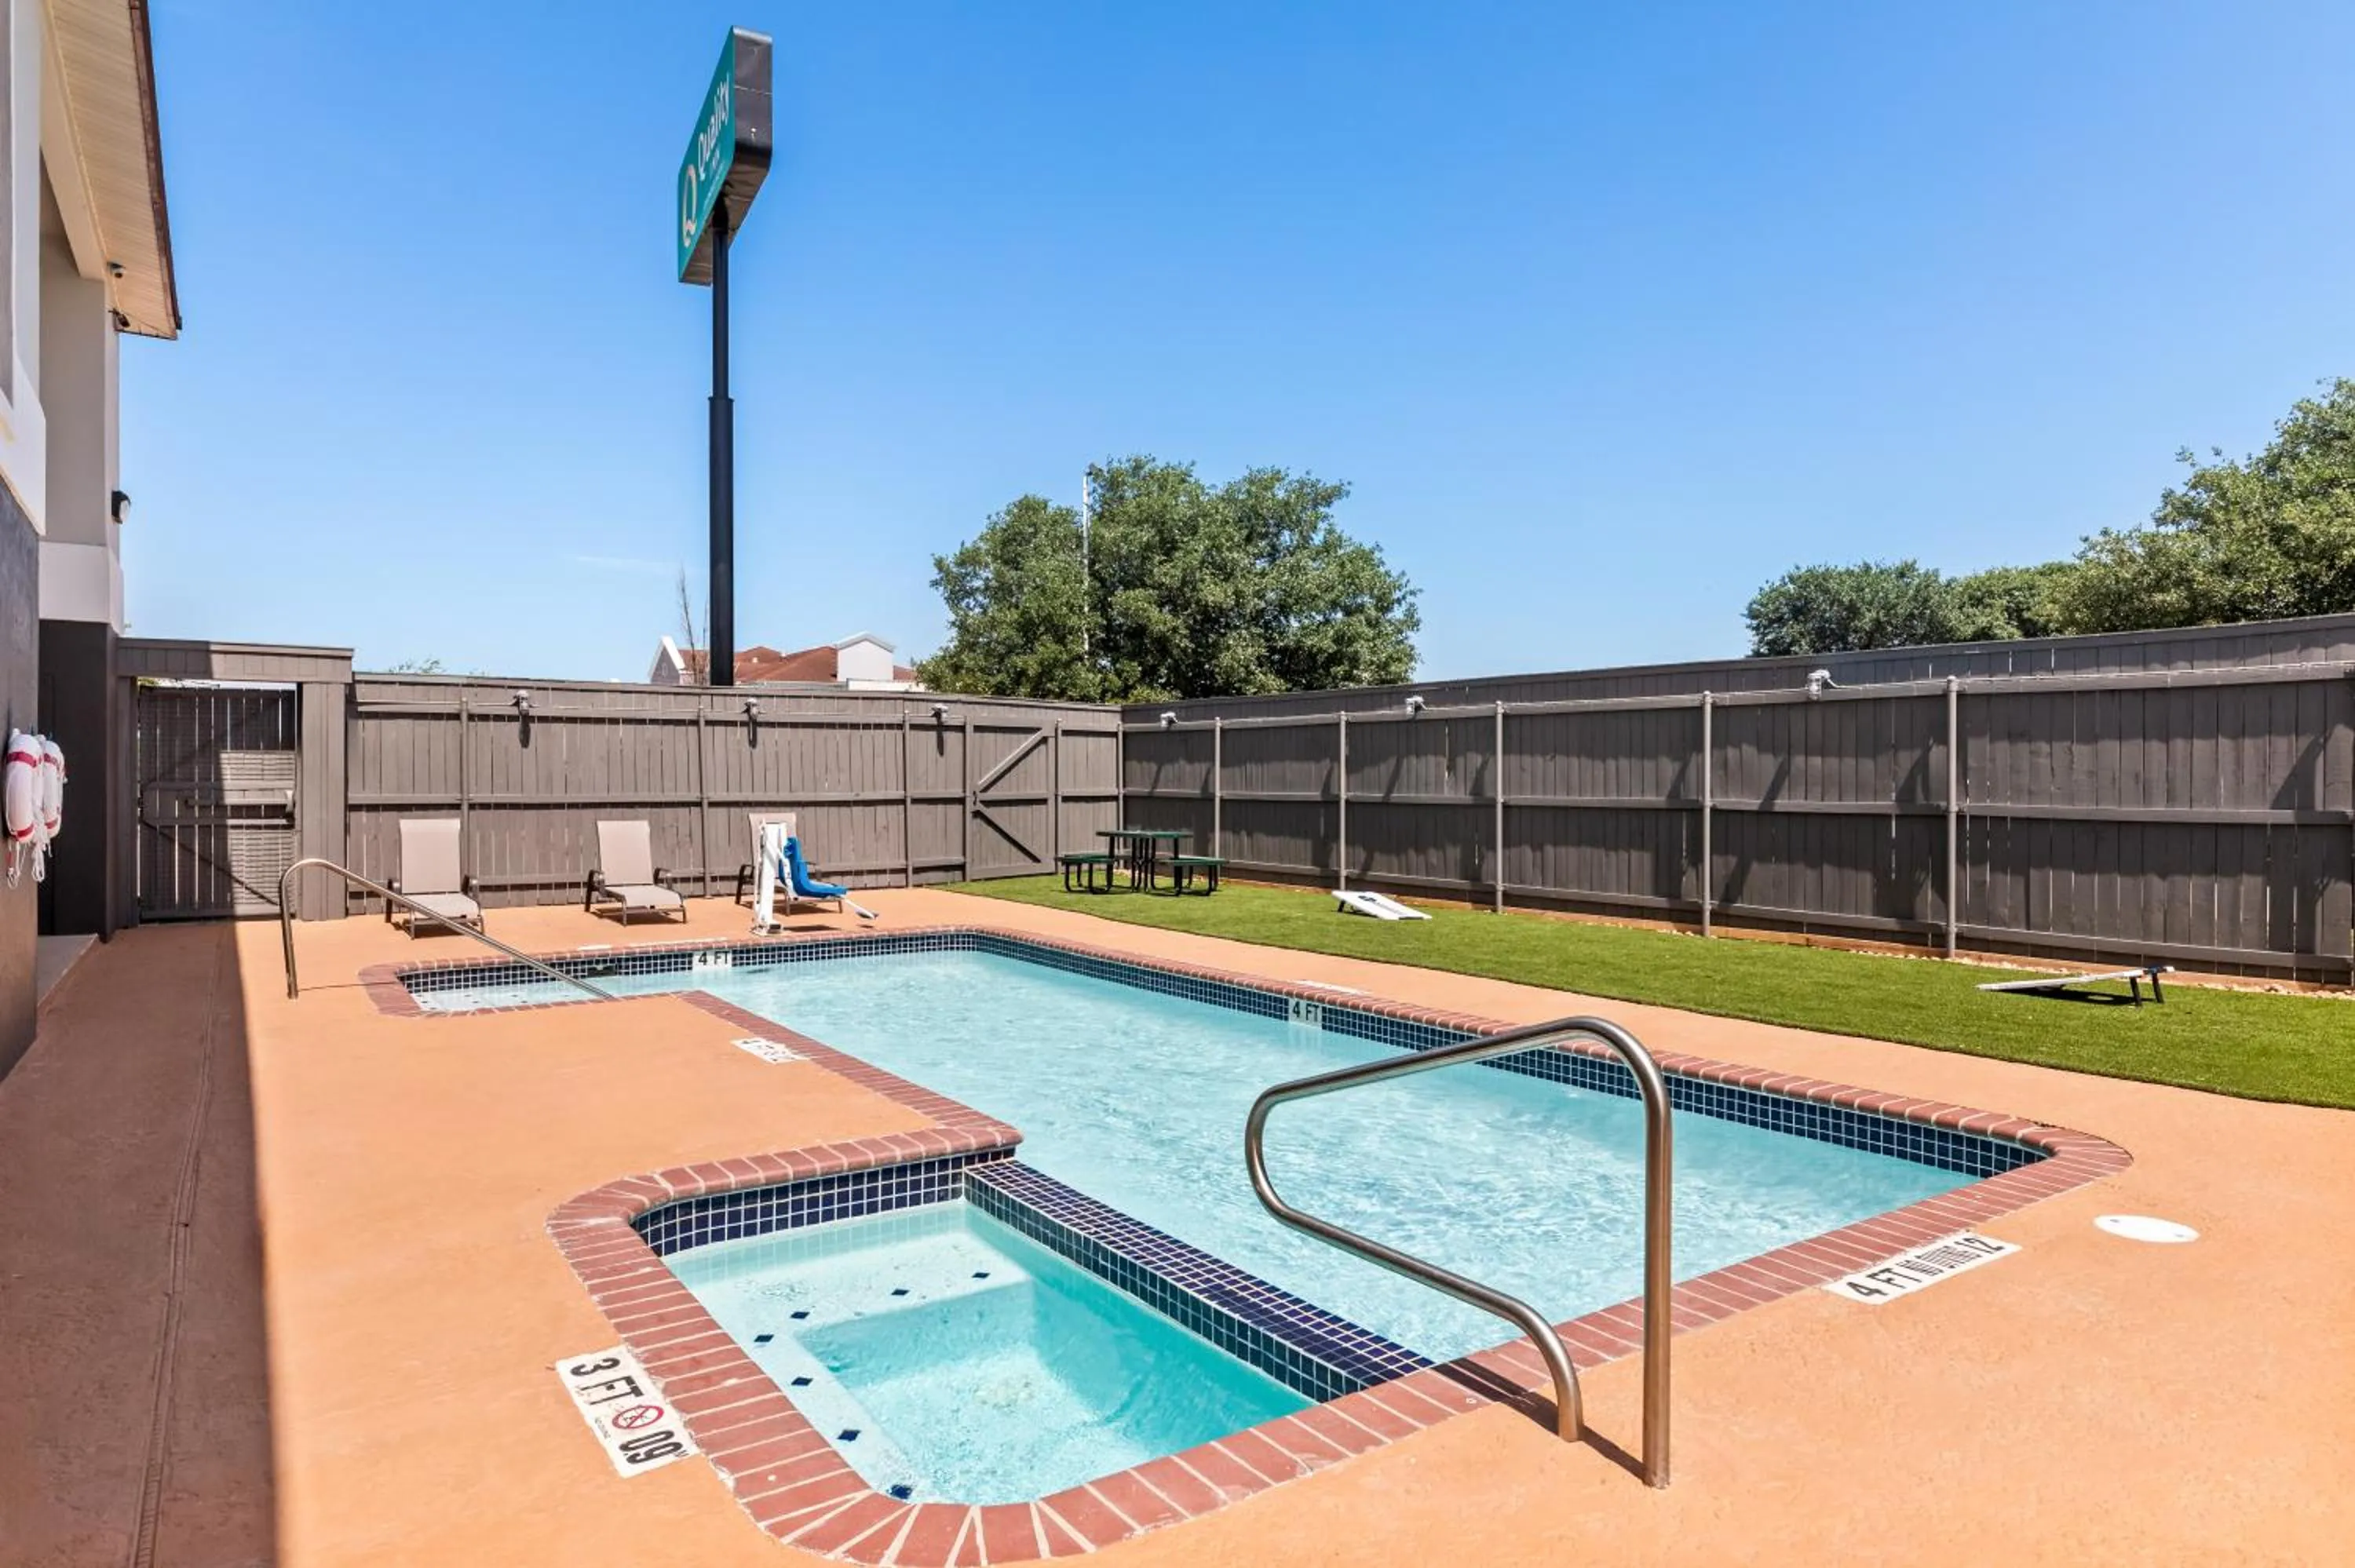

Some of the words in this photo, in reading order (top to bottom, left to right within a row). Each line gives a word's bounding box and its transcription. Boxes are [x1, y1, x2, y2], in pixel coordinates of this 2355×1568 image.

[698, 71, 730, 181] Quality
[698, 951, 707, 965] 4
[714, 950, 730, 965] FT
[1292, 1001, 1301, 1018] 4
[1305, 1002, 1319, 1022] FT
[1866, 1267, 1922, 1289] FT
[1846, 1282, 1889, 1296] 4
[570, 1358, 620, 1377] 3
[580, 1375, 644, 1406] FT
